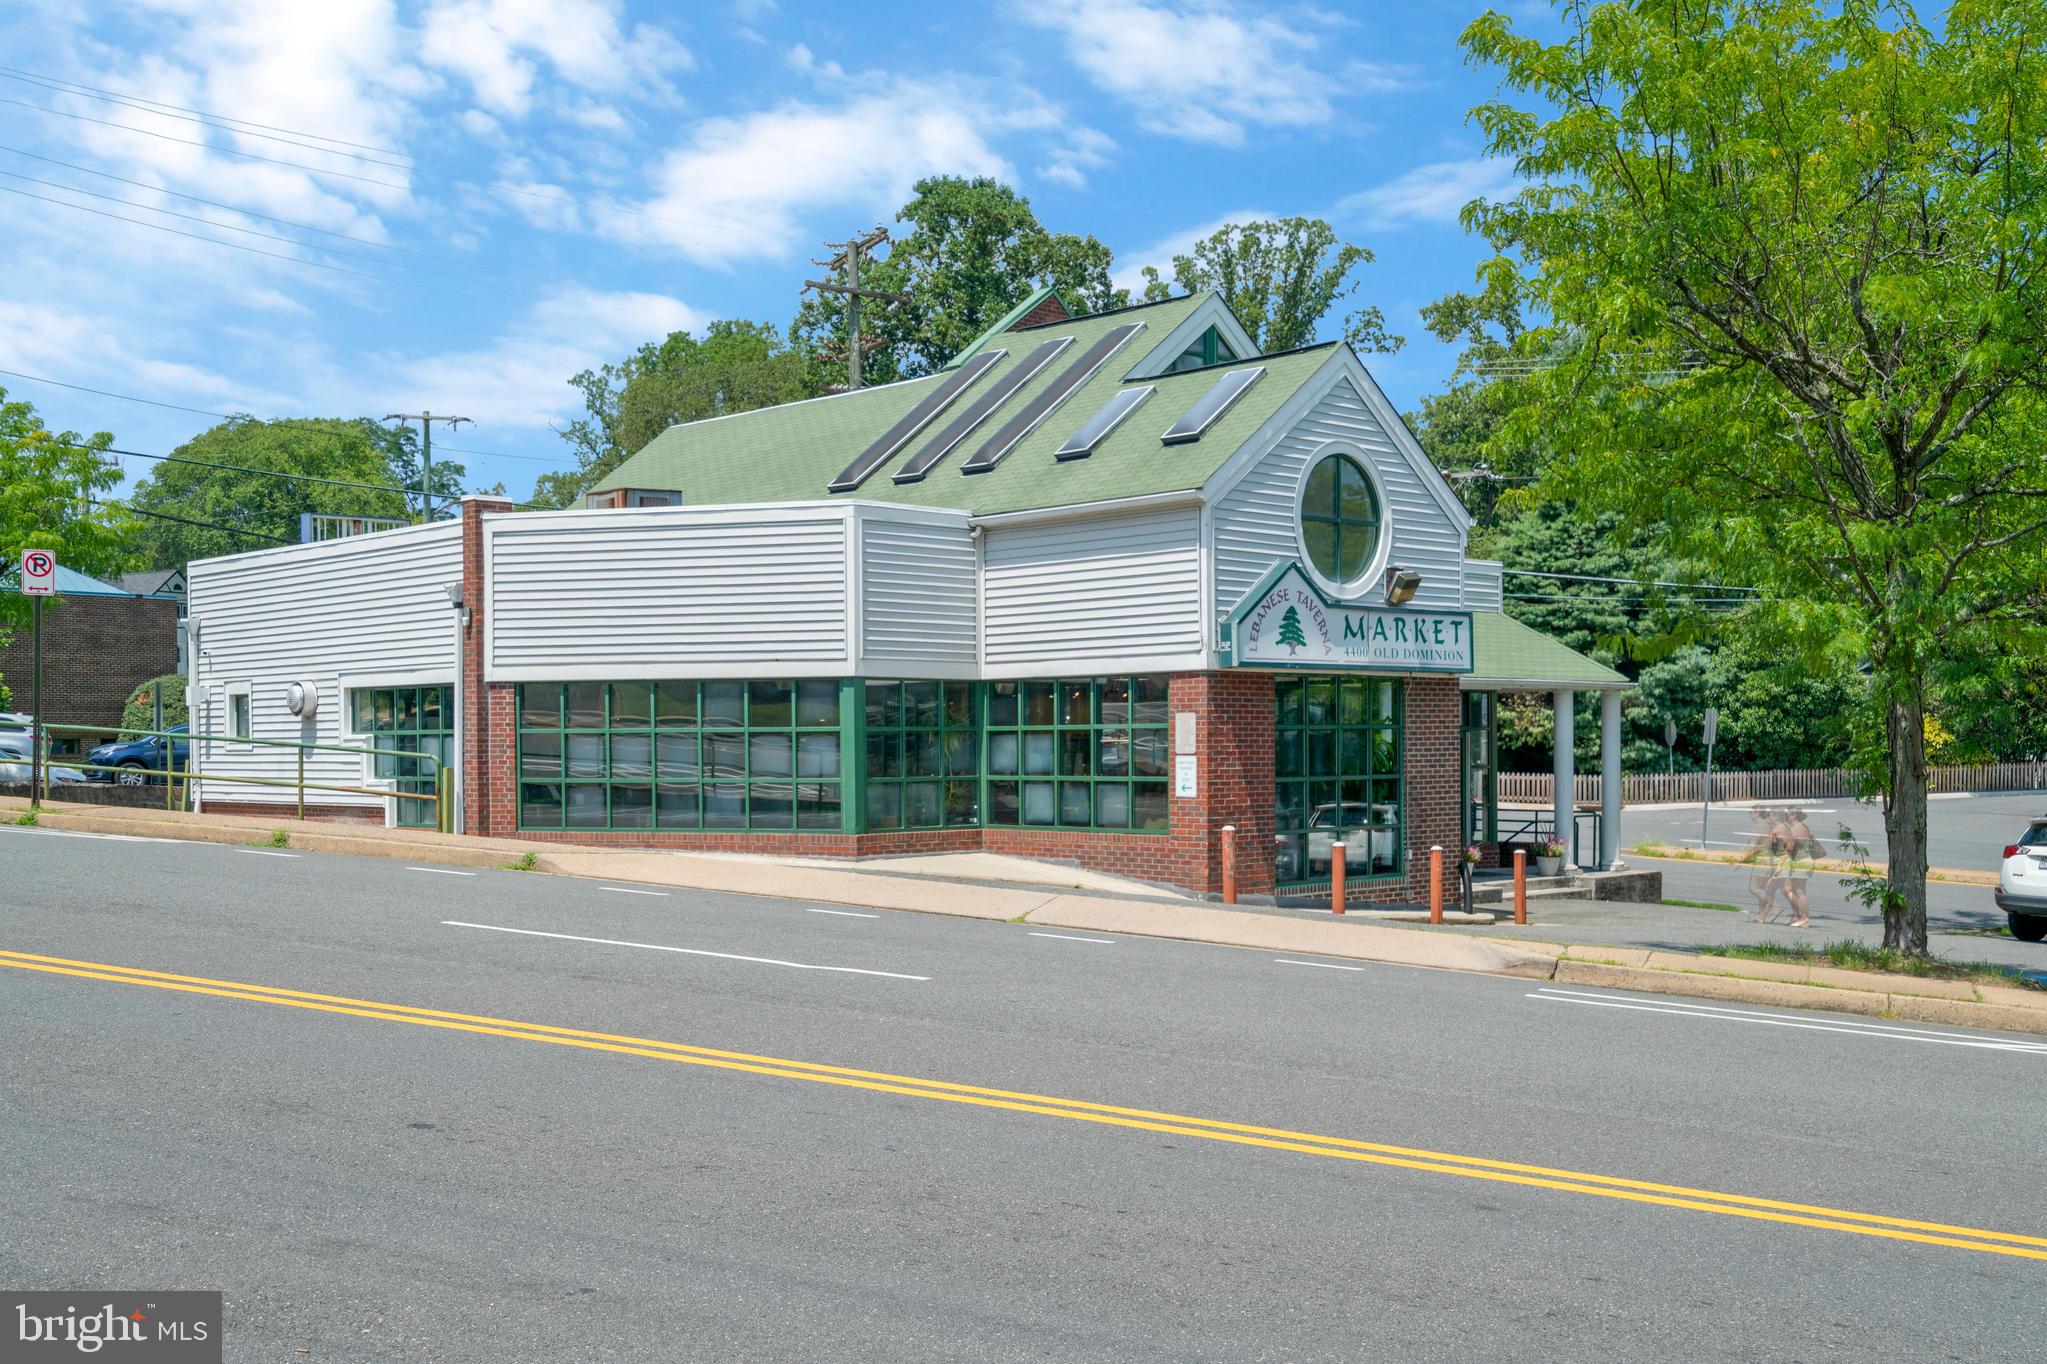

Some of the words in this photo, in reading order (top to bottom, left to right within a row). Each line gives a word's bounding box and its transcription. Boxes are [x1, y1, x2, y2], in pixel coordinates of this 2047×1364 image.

[1249, 588, 1290, 652] LEBANESE
[1297, 590, 1332, 656] TAVERNA
[1344, 647, 1368, 657] 4400
[1374, 647, 1399, 659] OLD
[1403, 648, 1464, 661] DOMINION
